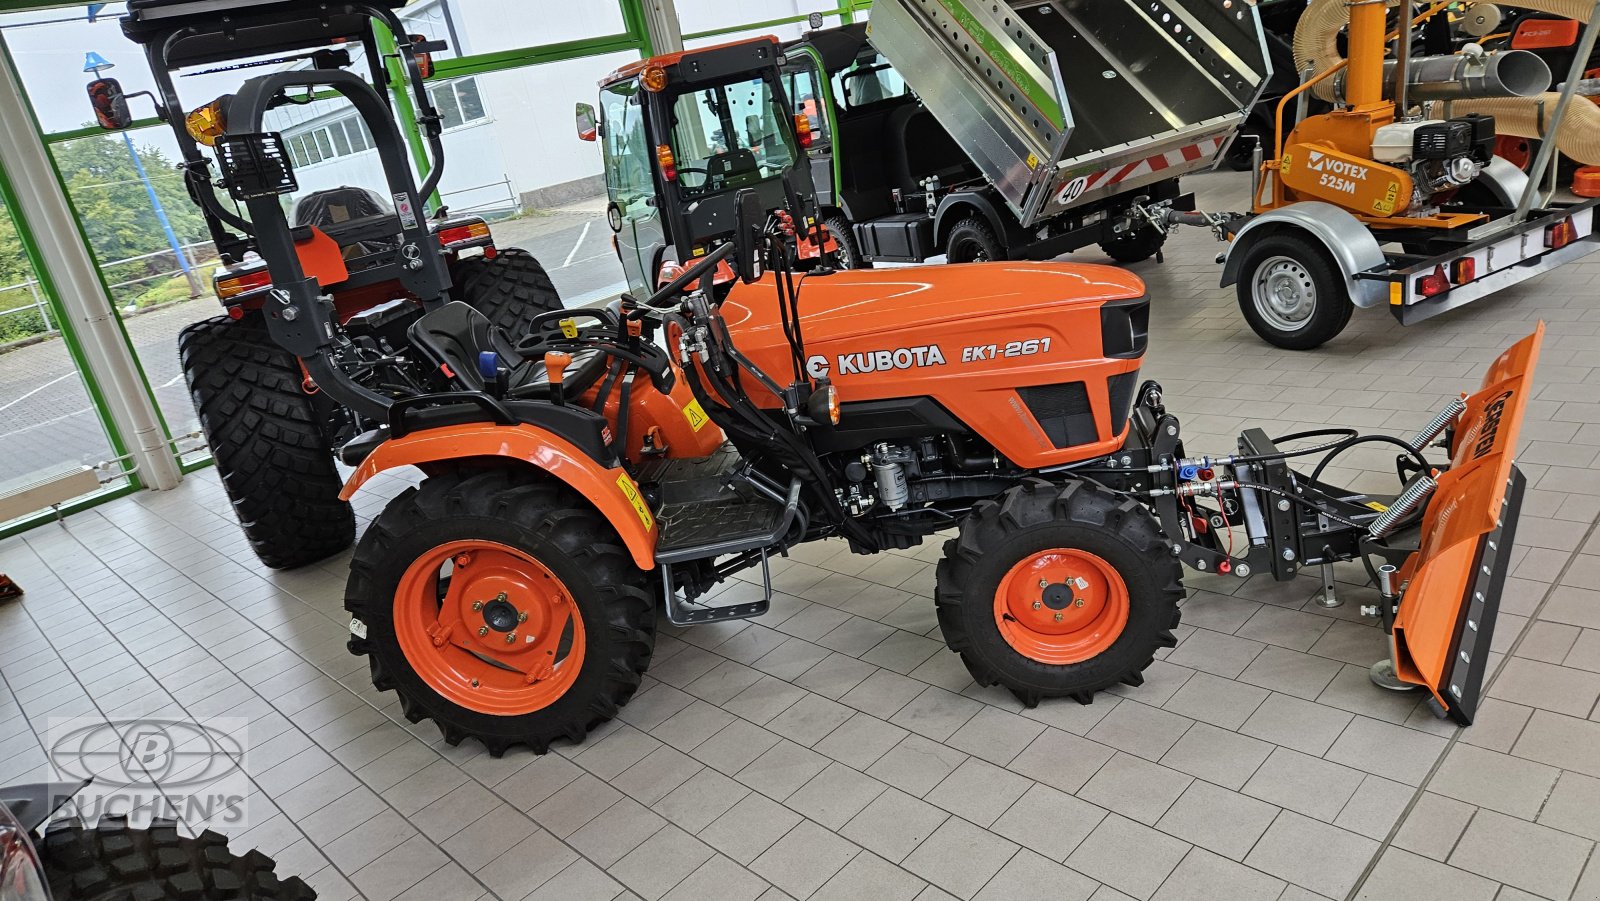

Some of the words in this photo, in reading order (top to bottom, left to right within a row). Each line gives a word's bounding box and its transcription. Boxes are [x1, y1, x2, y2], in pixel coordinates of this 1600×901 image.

[1325, 158, 1368, 180] VOTEX
[1061, 179, 1084, 203] 40
[1319, 173, 1356, 193] 525M
[837, 344, 946, 376] KUBOTA
[961, 337, 1052, 363] EK1-261
